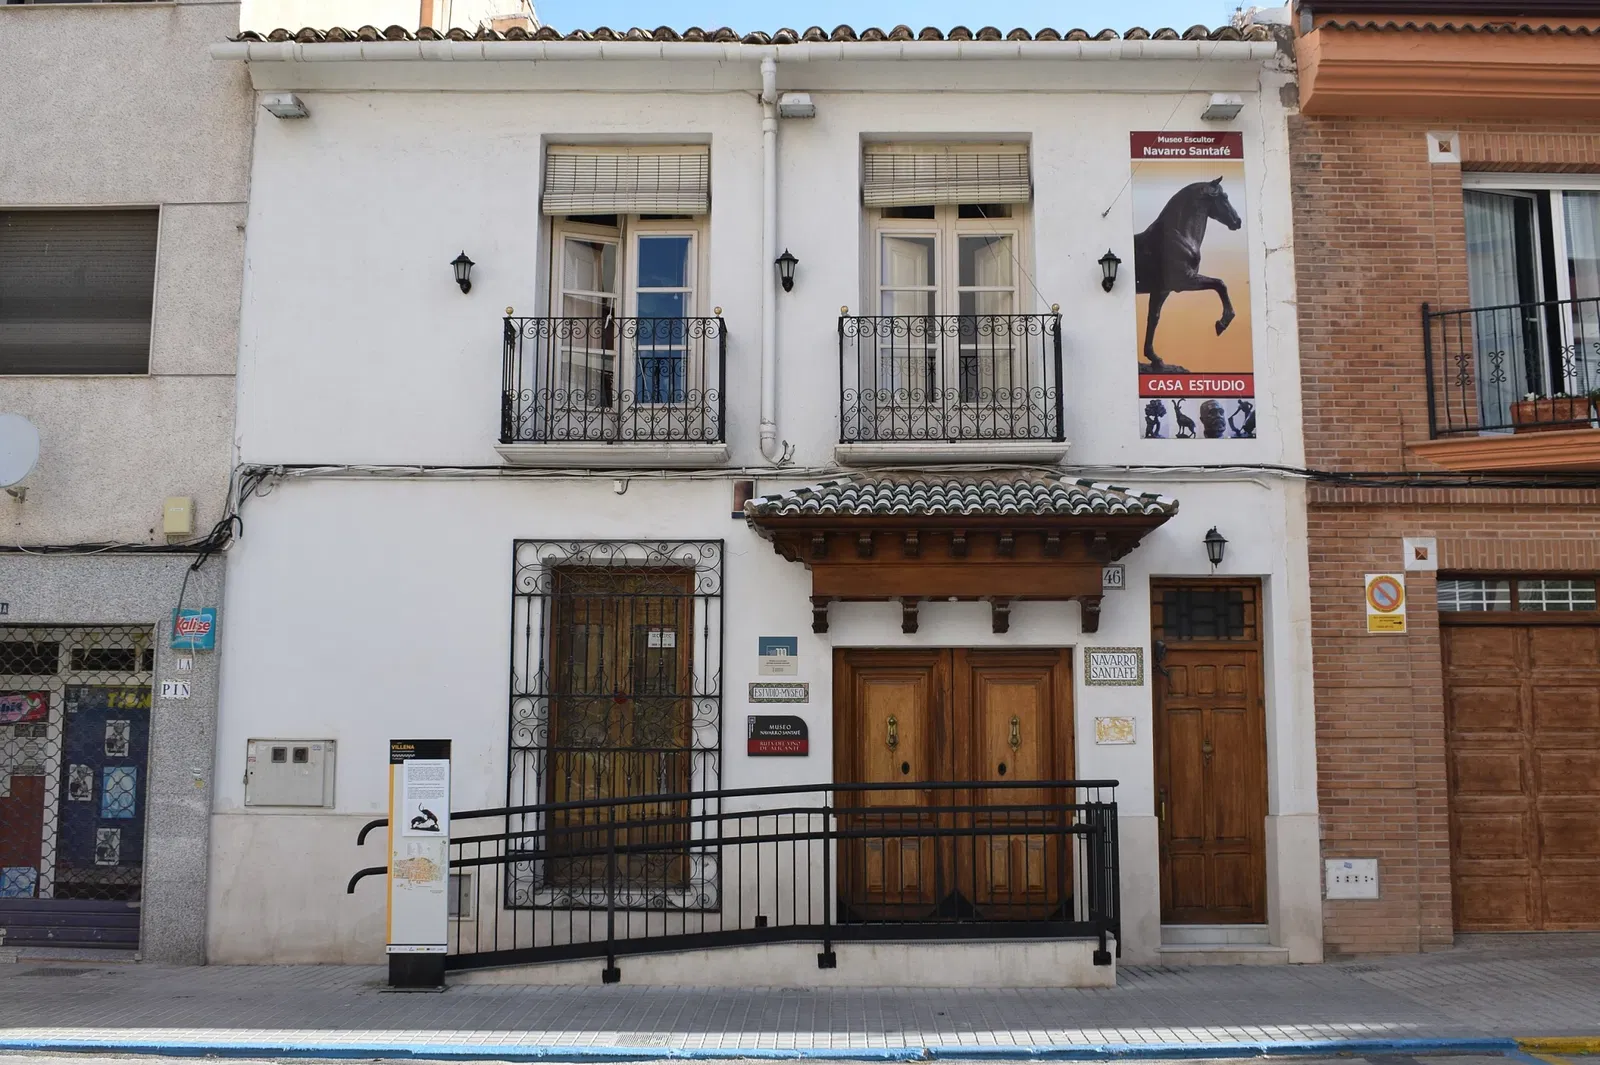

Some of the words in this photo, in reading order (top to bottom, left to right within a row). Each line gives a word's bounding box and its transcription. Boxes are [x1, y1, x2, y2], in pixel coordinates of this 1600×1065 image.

[1143, 147, 1186, 156] Navarro
[1189, 146, 1231, 156] Santafé
[1148, 380, 1183, 391] CASA
[1189, 380, 1245, 391] ESTUDIO
[1104, 570, 1120, 584] 46
[174, 616, 211, 636] Kalise
[1091, 654, 1137, 667] NAVARRO
[1092, 667, 1137, 679] SANTAFE
[162, 684, 190, 696] PIN
